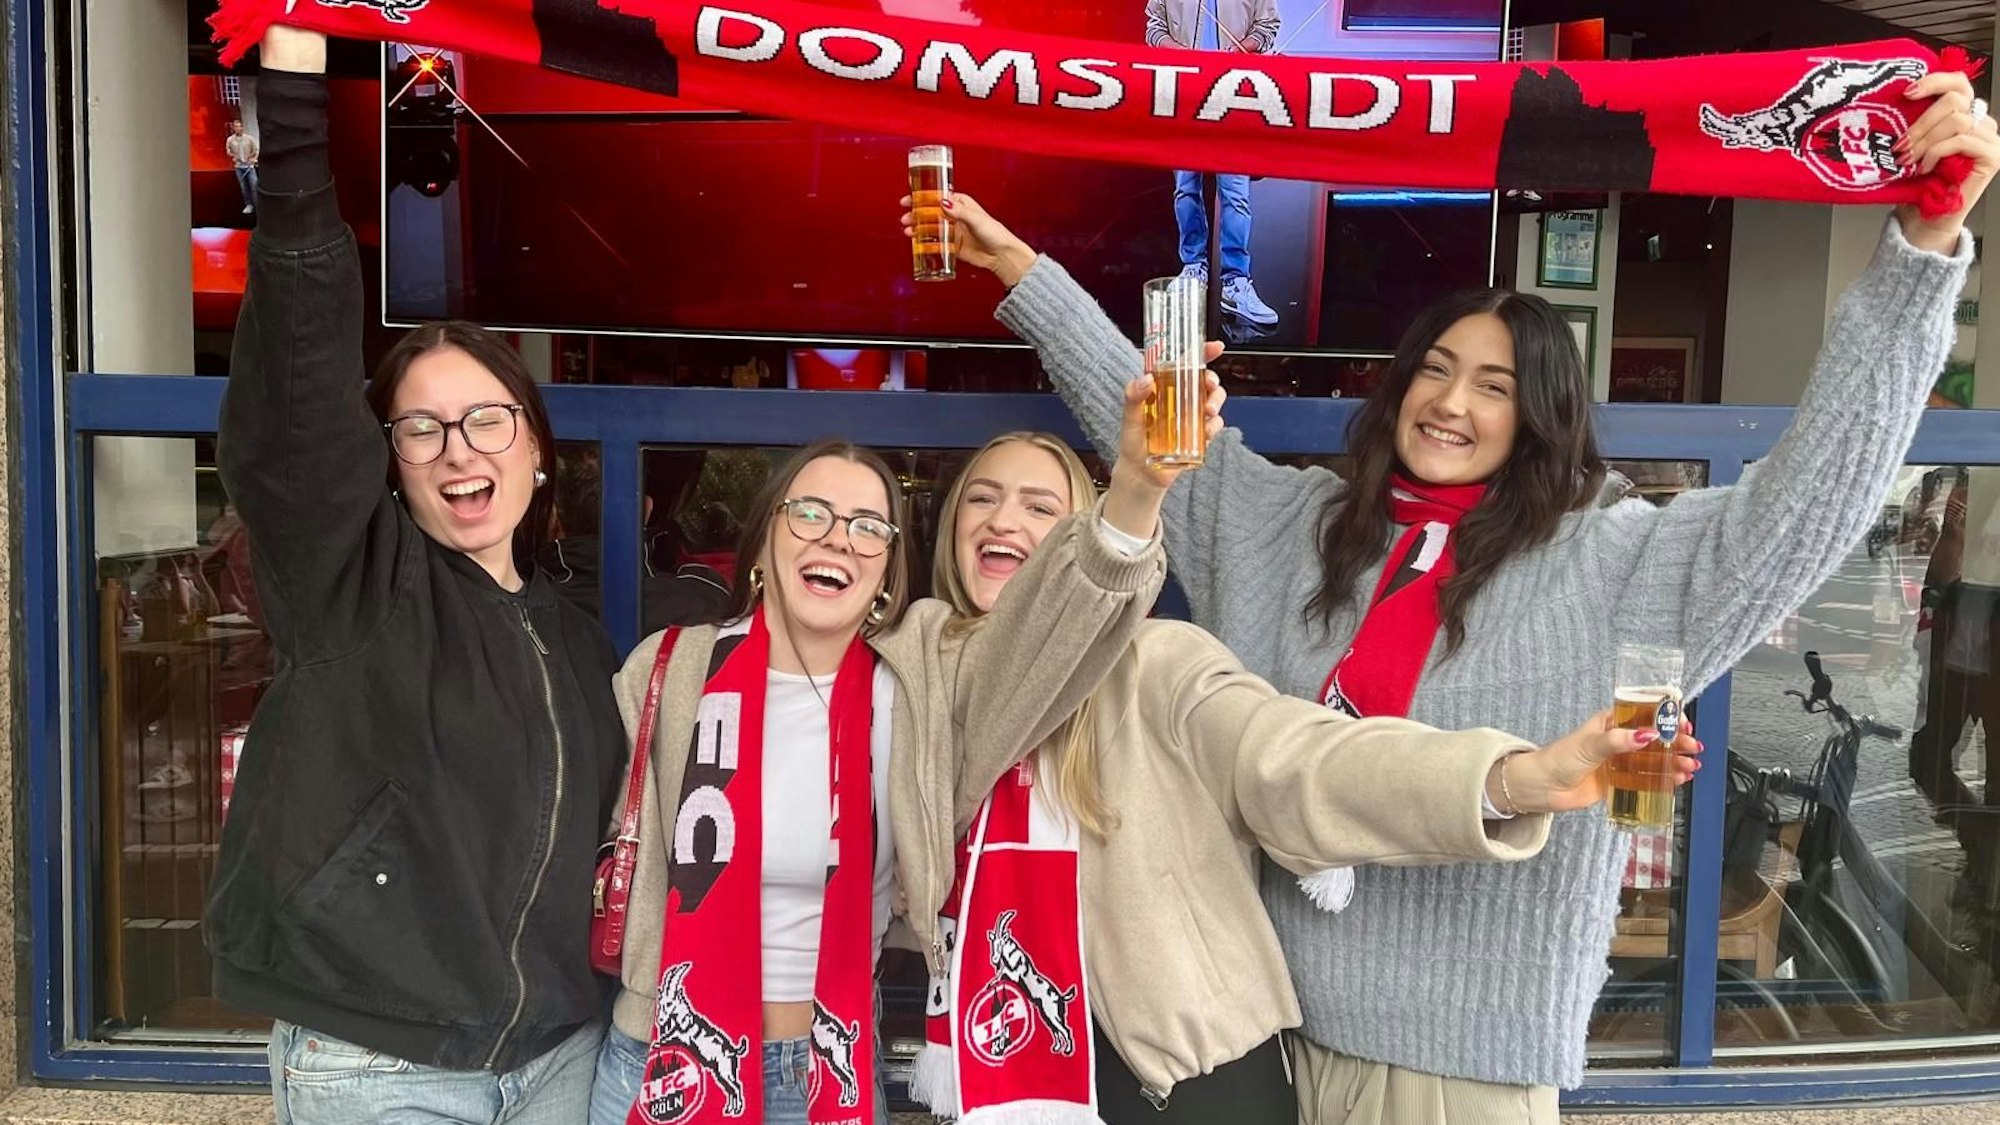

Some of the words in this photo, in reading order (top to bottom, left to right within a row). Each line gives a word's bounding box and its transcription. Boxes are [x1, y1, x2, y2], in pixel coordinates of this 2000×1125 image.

[694, 6, 1477, 134] DOMSTADT
[1843, 126, 1869, 156] FC
[662, 1071, 684, 1095] FC
[651, 1094, 683, 1116] KÖLN
